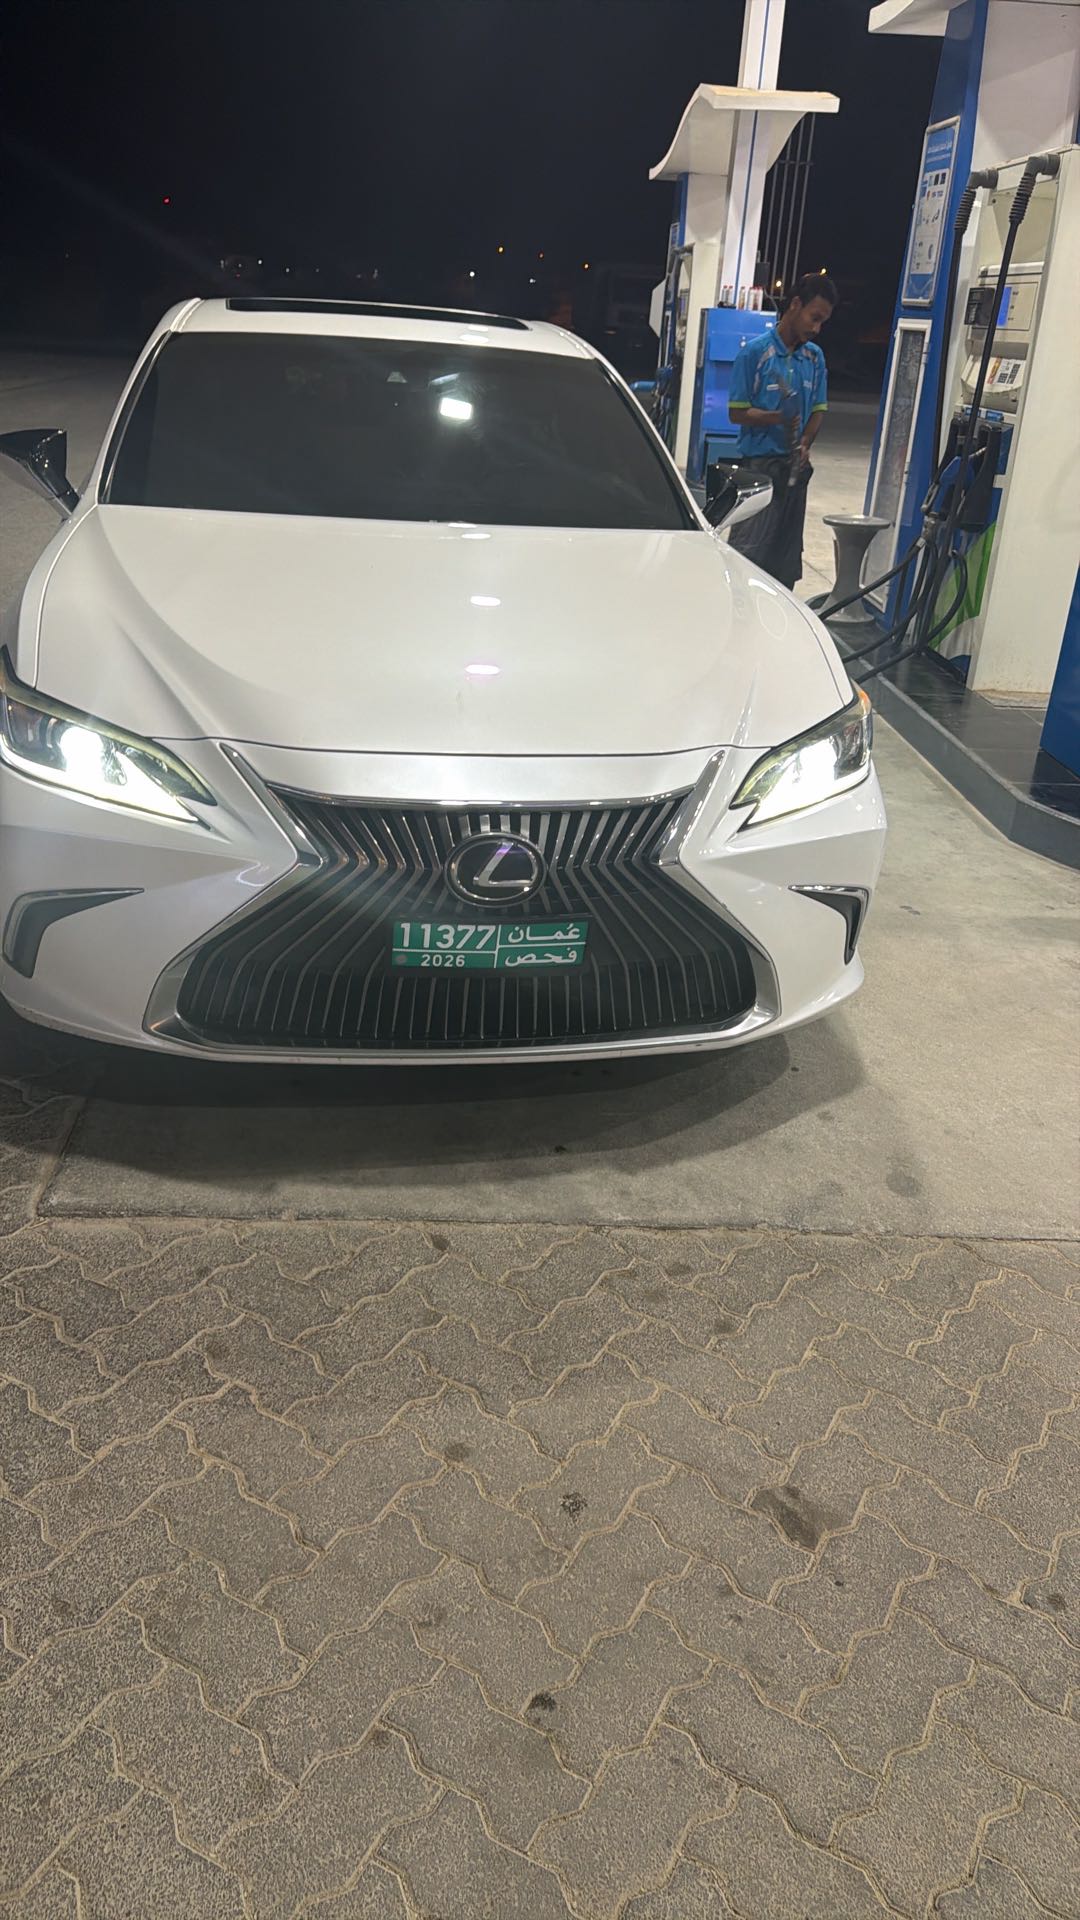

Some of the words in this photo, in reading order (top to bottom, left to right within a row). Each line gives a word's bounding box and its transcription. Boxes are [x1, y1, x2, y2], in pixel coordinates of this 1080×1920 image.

[400, 922, 496, 950] 11377
[420, 953, 466, 967] 2026
[504, 947, 578, 967] فحص
